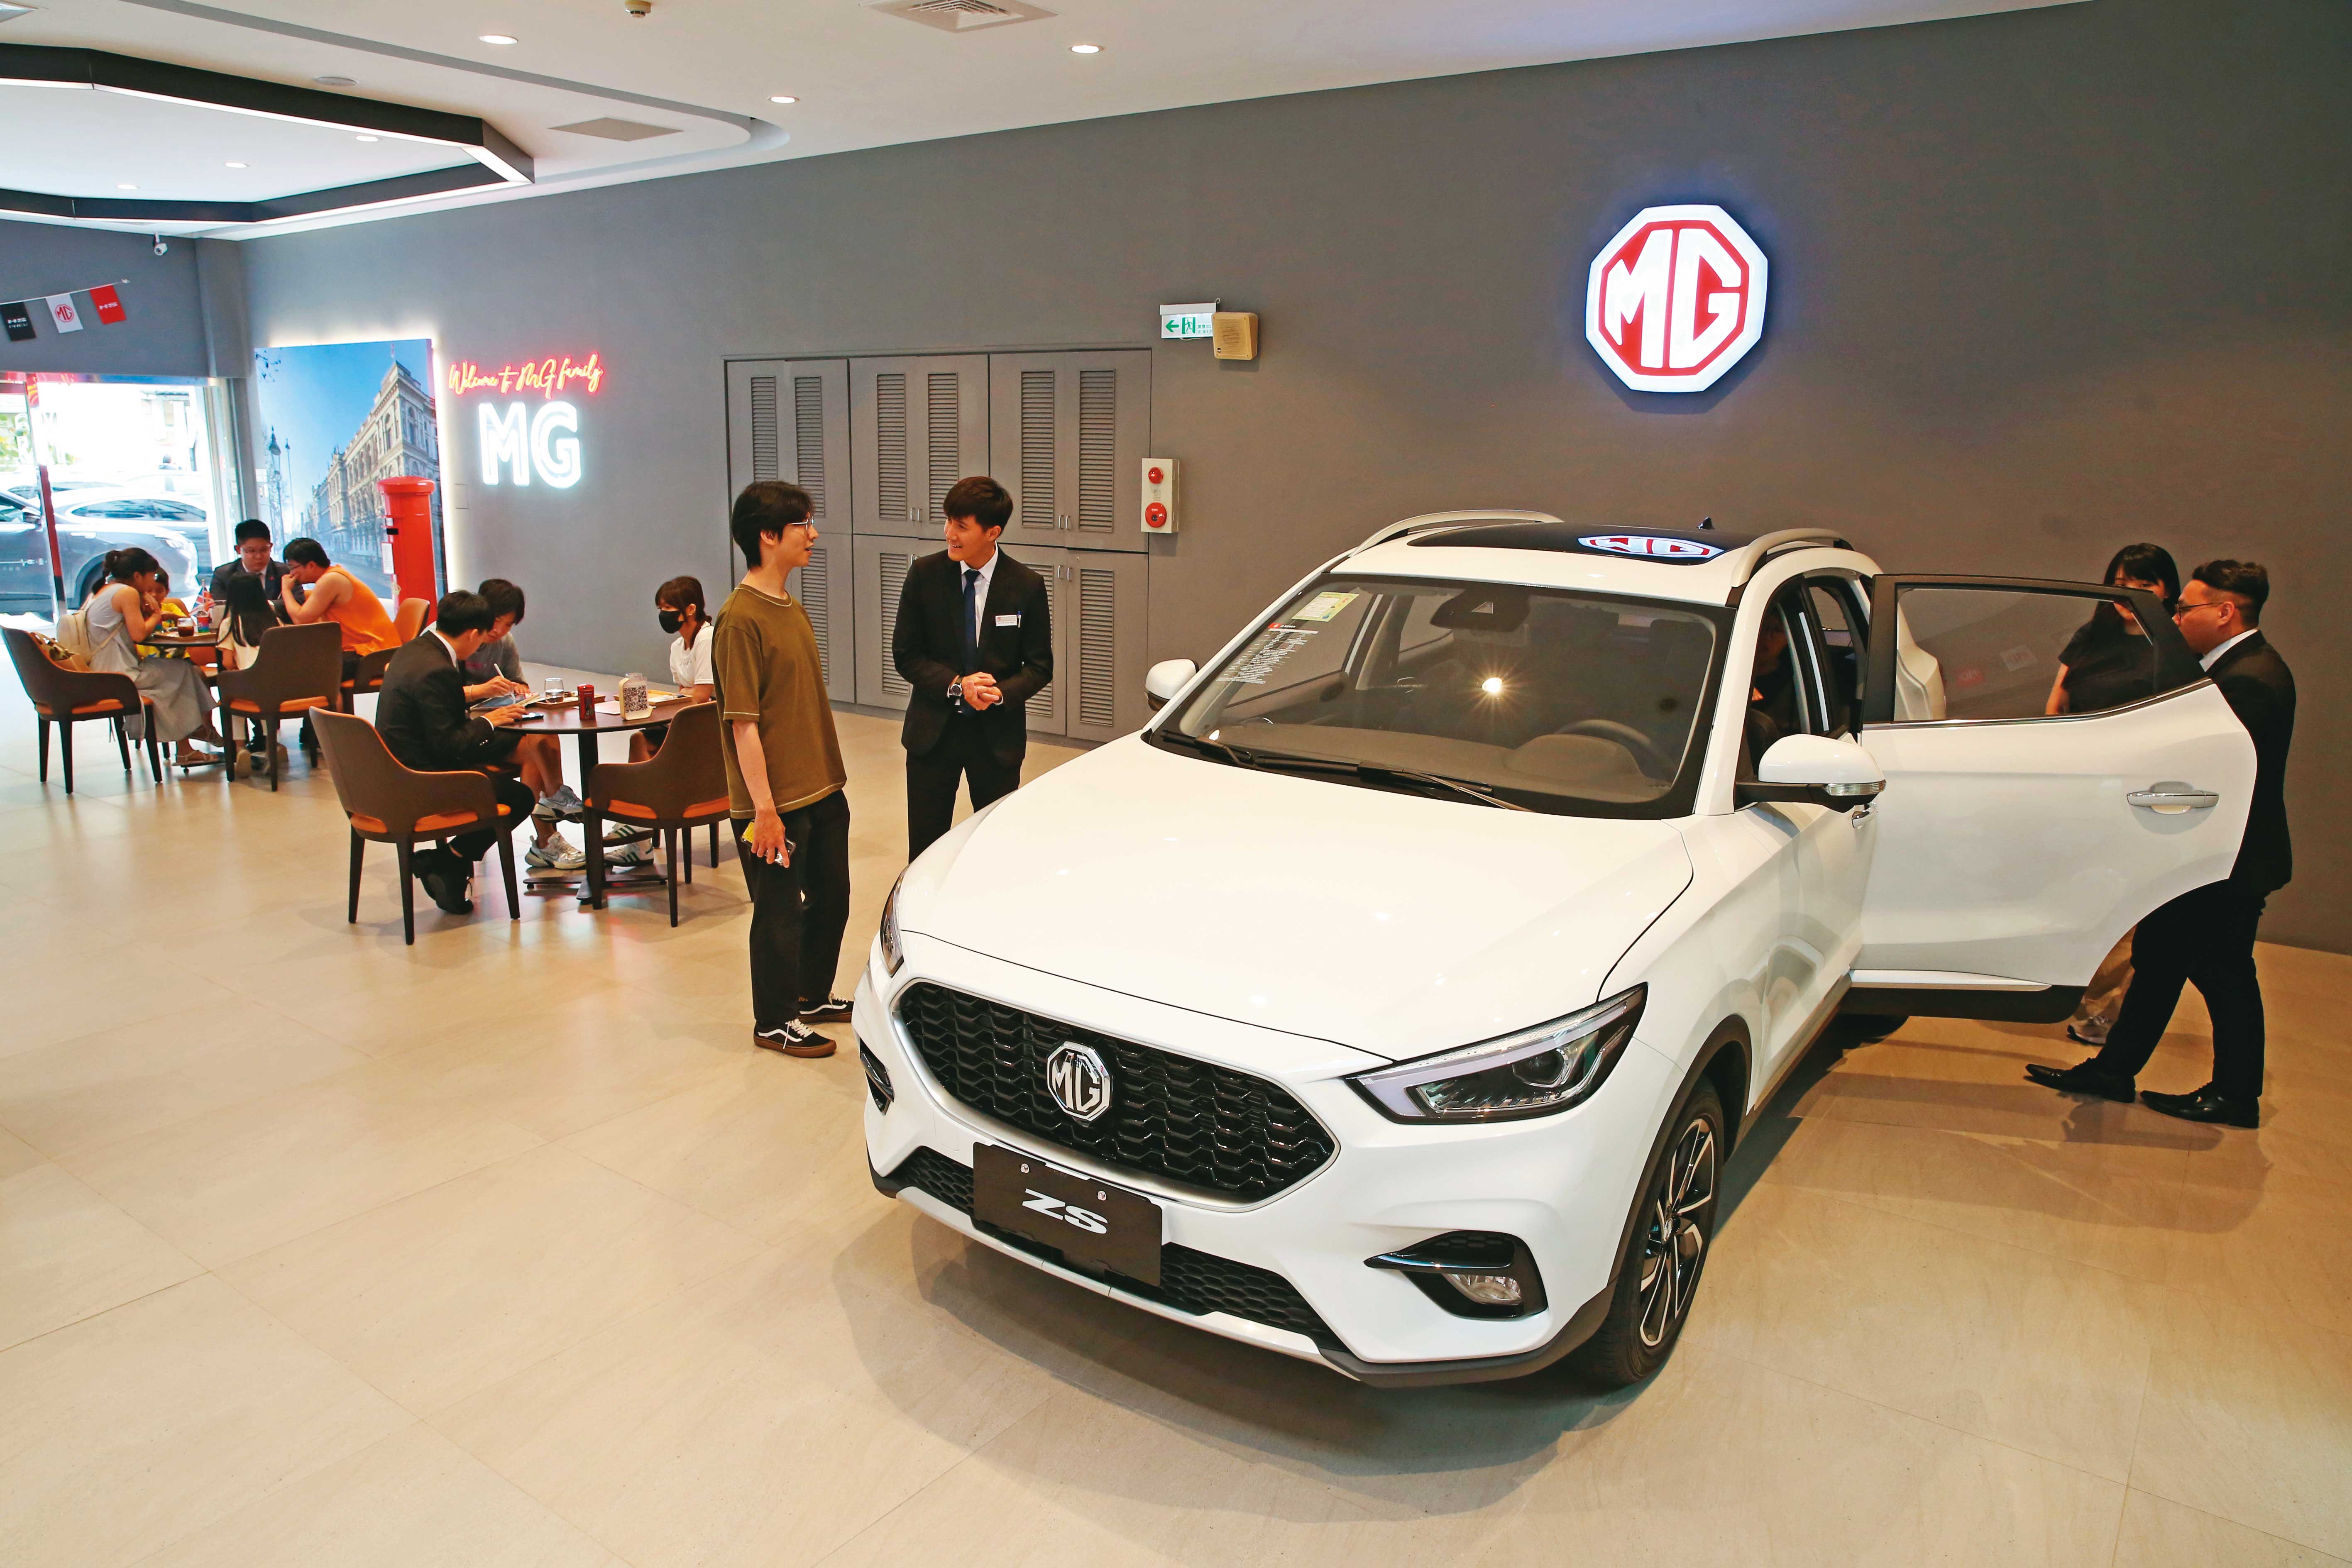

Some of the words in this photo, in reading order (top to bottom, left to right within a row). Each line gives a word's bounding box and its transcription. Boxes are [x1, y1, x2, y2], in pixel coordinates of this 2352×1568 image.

[56, 306, 73, 321] MG
[1604, 227, 1742, 369] MG
[448, 360, 499, 395] Welcome
[515, 362, 557, 399] MG
[478, 401, 582, 489] MG
[1052, 1051, 1100, 1112] MG
[1022, 1188, 1108, 1234] ZS
